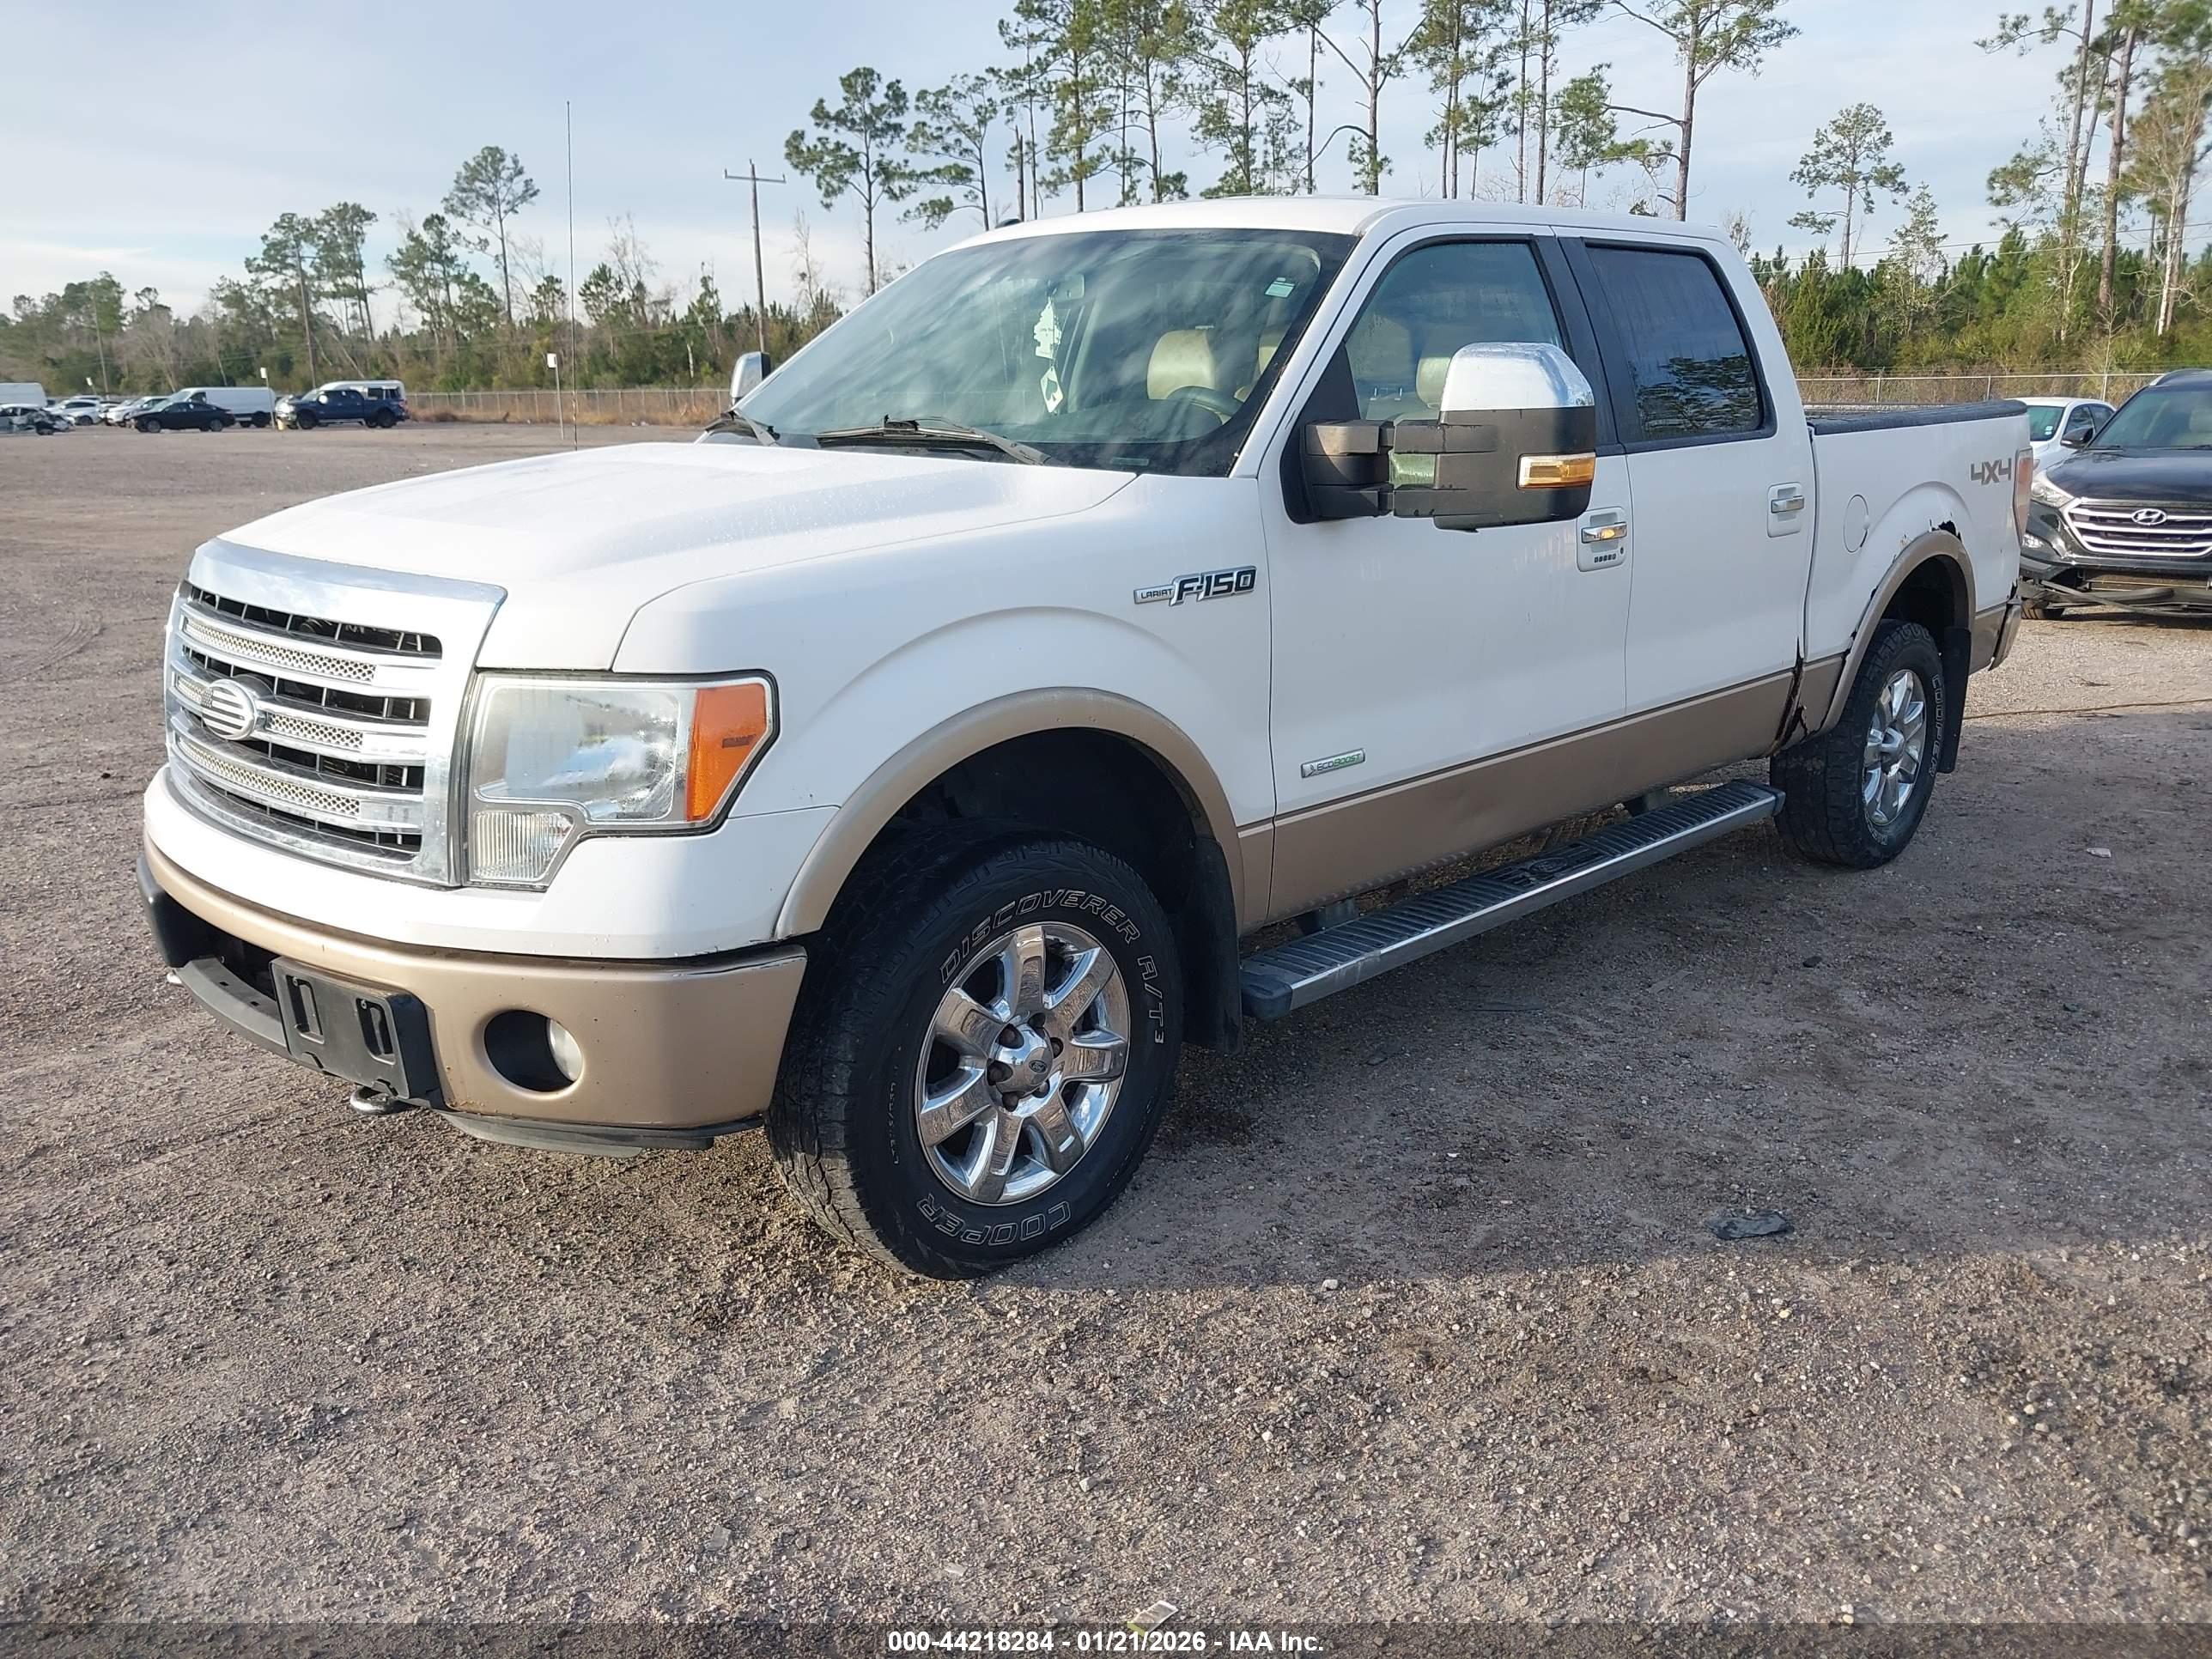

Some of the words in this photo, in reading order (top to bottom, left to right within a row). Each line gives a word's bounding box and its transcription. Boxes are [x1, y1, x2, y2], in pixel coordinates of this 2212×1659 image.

[1140, 587, 1173, 599] LARIAT
[1173, 568, 1257, 603] F-150
[939, 889, 1140, 984] DISCOVERER
[915, 1193, 1072, 1247] COOPER
